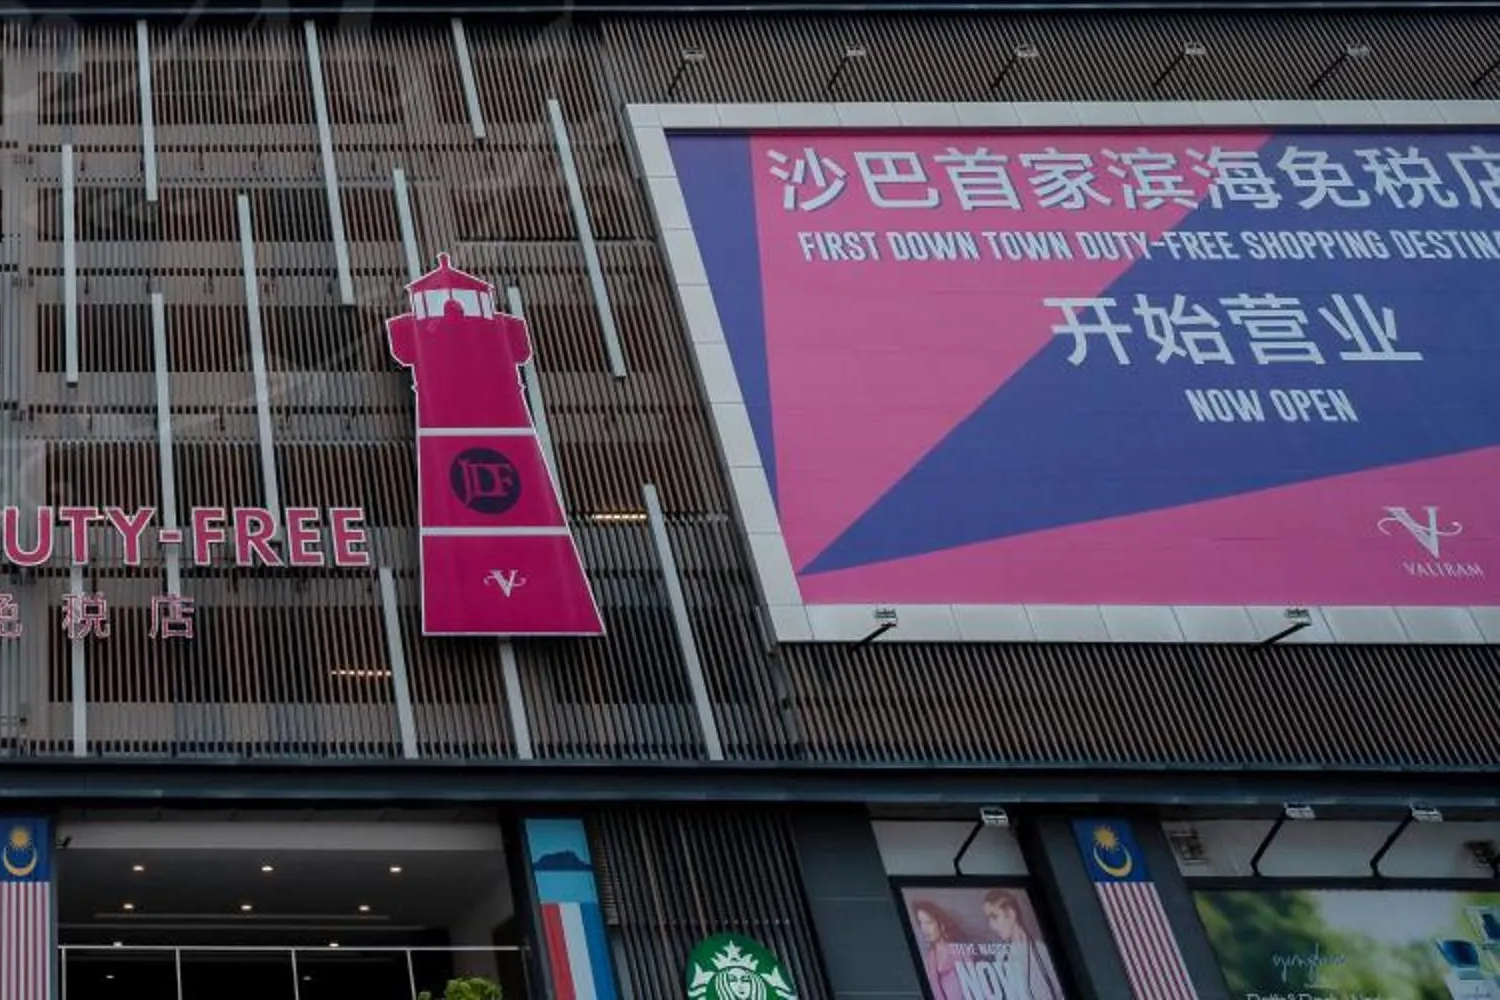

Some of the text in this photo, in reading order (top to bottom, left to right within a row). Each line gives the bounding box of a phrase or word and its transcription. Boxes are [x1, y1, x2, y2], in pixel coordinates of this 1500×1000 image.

[767, 145, 1500, 212] 沙巴首家滨海免税店
[799, 231, 880, 261] FIRST
[887, 231, 979, 261] DOWN
[983, 231, 1071, 261] TOWN
[1076, 231, 1240, 261] DUTY-FREE
[1242, 230, 1391, 261] SHOPPING
[1043, 294, 1424, 366] 开始营业
[1185, 389, 1359, 423] NOW OPEN
